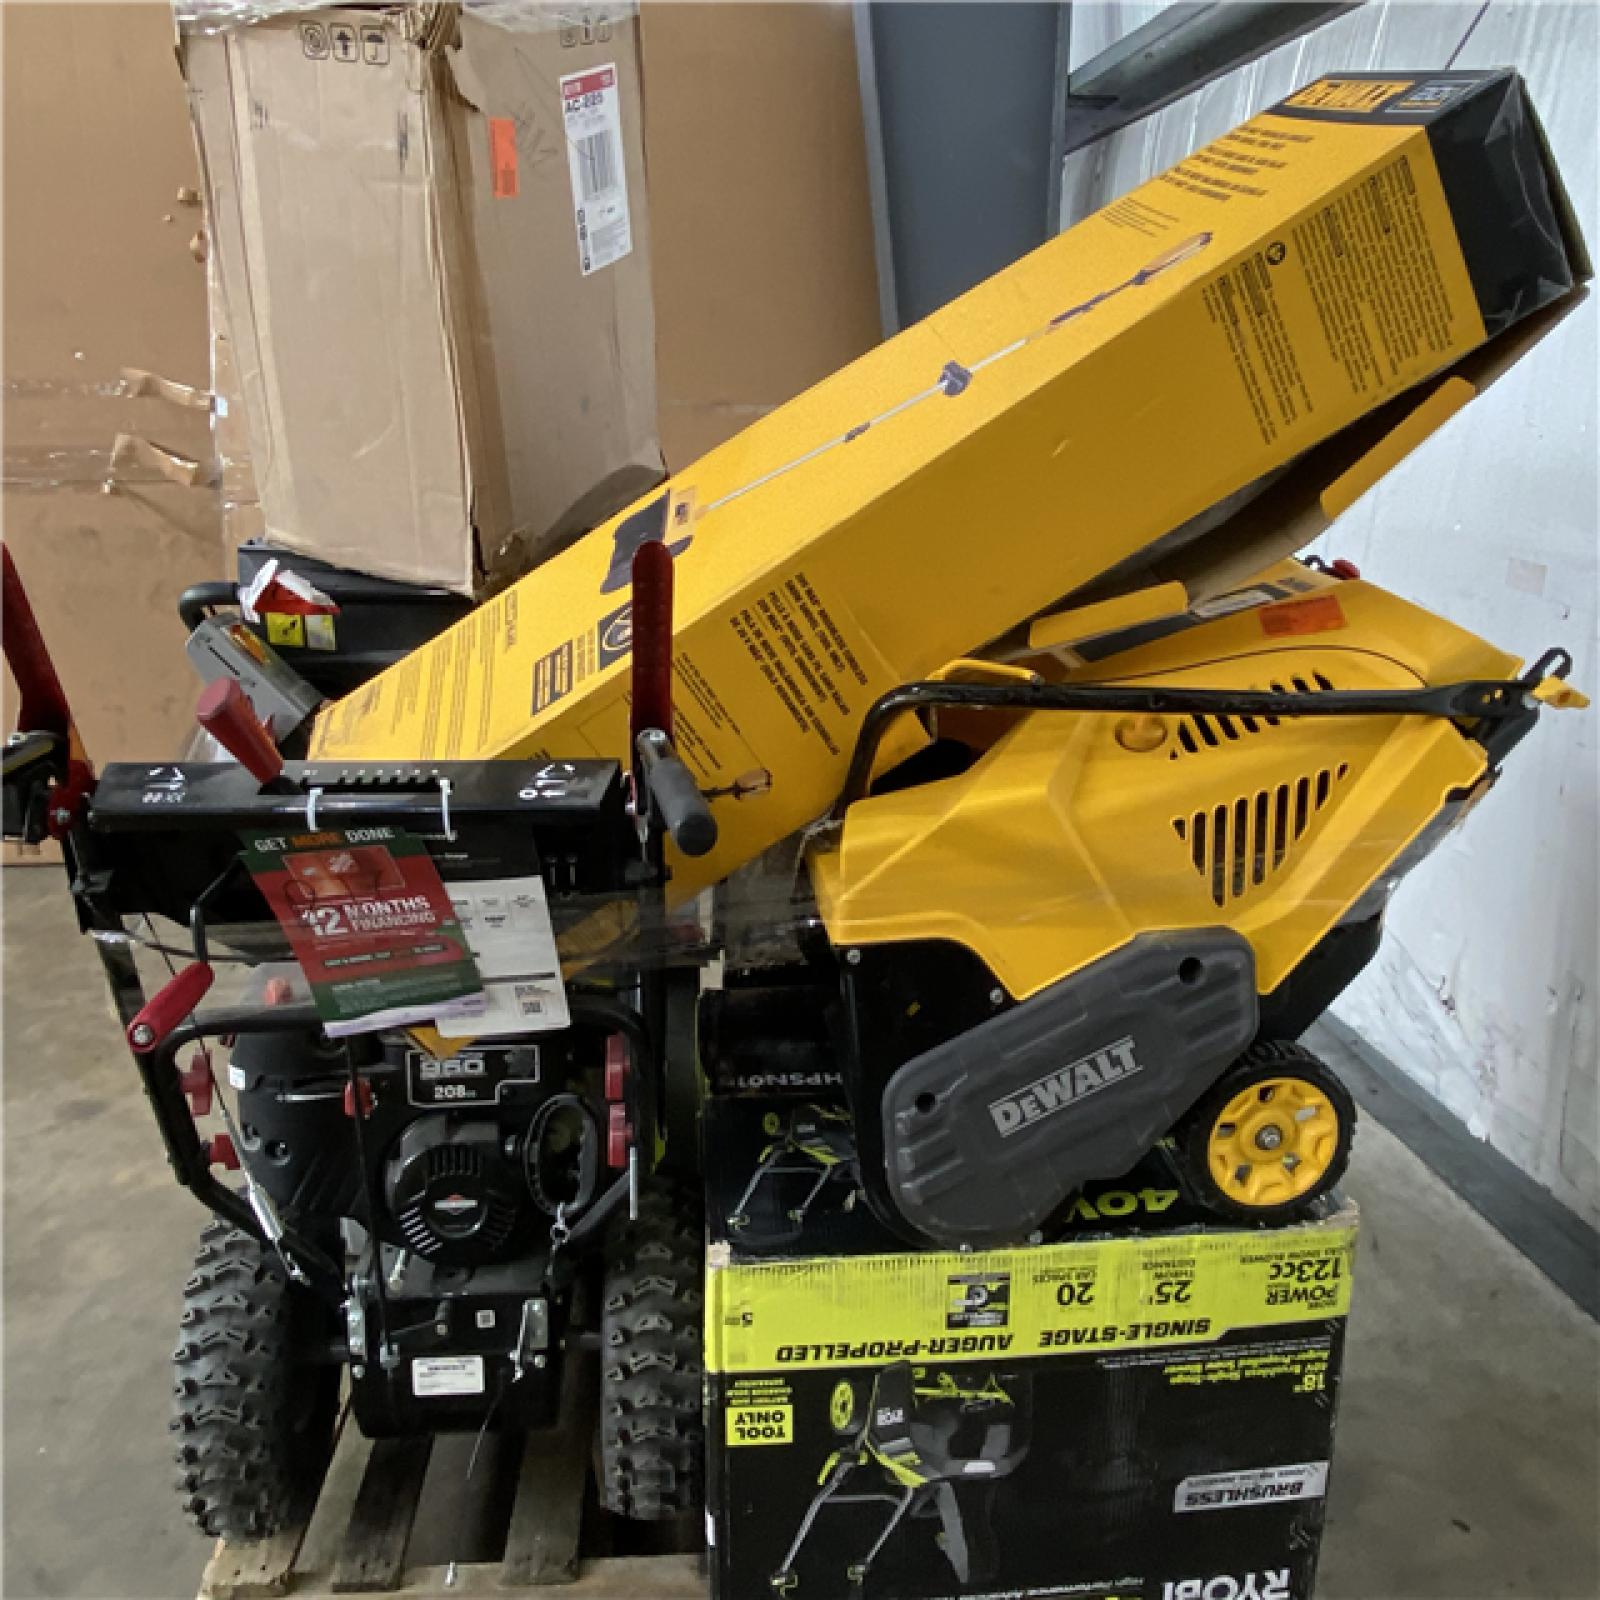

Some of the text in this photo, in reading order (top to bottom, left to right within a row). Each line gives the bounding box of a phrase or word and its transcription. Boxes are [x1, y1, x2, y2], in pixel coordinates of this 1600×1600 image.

[254, 838, 287, 851] GET
[344, 826, 395, 843] DONE
[302, 905, 348, 936] 12
[342, 895, 431, 916] MONTHS
[1269, 1258, 1341, 1284] 123cc
[1056, 1282, 1095, 1305] 20
[1264, 1285, 1339, 1304] POWER
[775, 1317, 1210, 1363] SINGLE-STAGE AUGER-PROPELLED
[735, 1409, 786, 1425] ONLY
[735, 1426, 786, 1440] TOOL
[1185, 1483, 1304, 1504] BRUSHLESS
[1164, 1568, 1291, 1600] RYOBI
